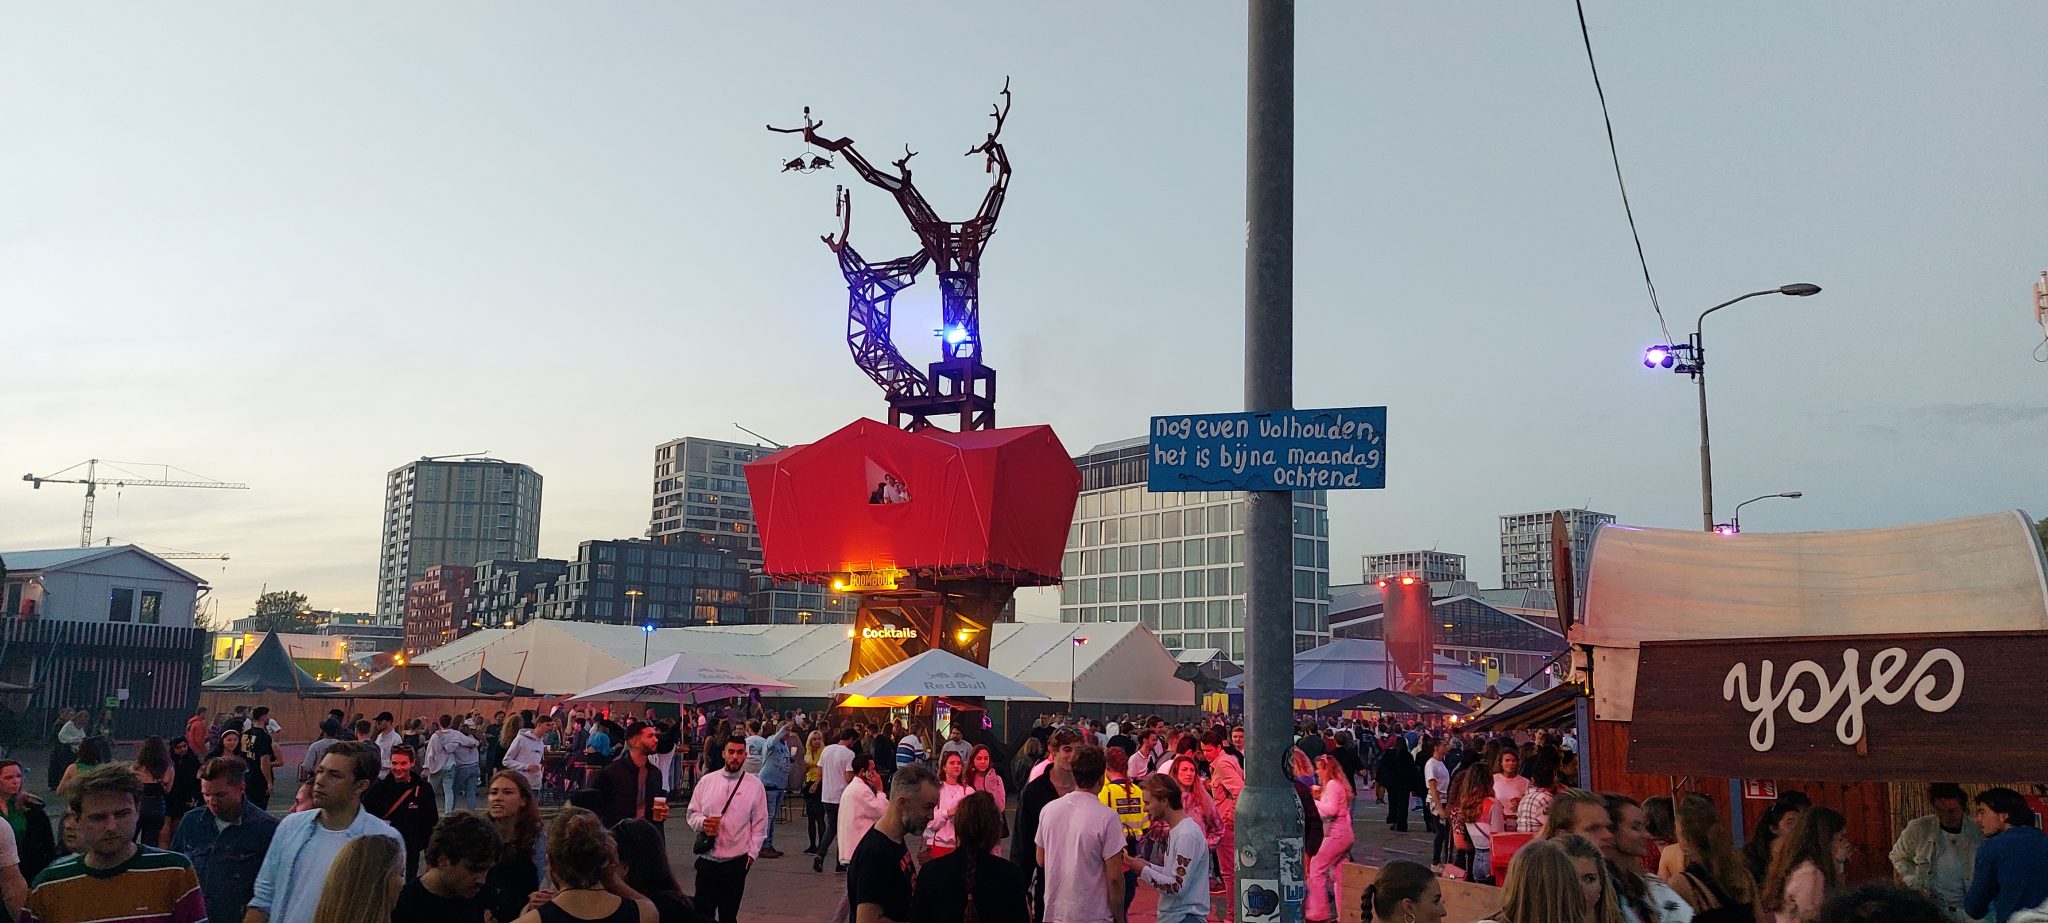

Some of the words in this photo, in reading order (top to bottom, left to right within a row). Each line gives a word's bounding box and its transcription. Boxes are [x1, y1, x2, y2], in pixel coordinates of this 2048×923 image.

[1156, 417, 1191, 440] nog
[1196, 417, 1249, 440] even
[1154, 443, 1188, 466] het
[1195, 445, 1211, 469] is
[1220, 443, 1277, 475] bijna
[1287, 444, 1380, 469] maandag
[862, 627, 918, 639] Cocktails
